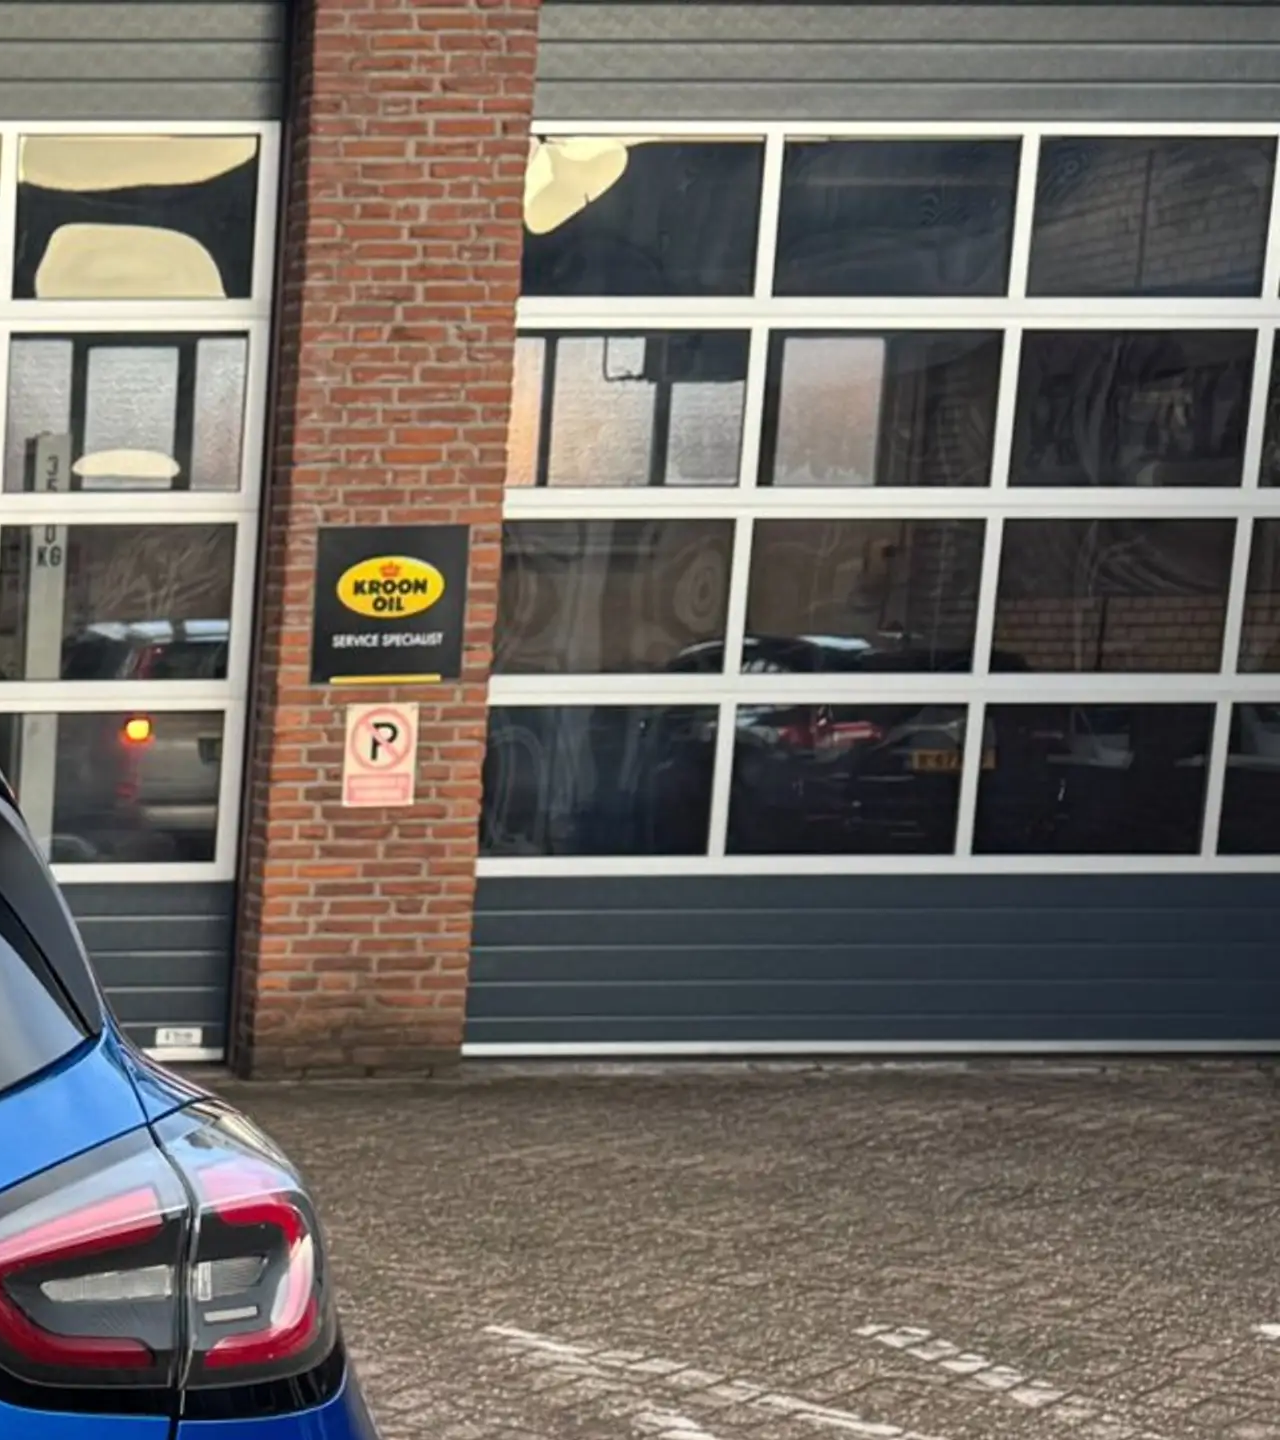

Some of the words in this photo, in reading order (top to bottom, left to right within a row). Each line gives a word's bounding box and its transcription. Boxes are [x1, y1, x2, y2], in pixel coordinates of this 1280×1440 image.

[353, 577, 427, 595] KROON
[372, 596, 405, 611] OIL
[332, 633, 379, 648] SERVICE
[382, 631, 444, 647] SPECIALIST
